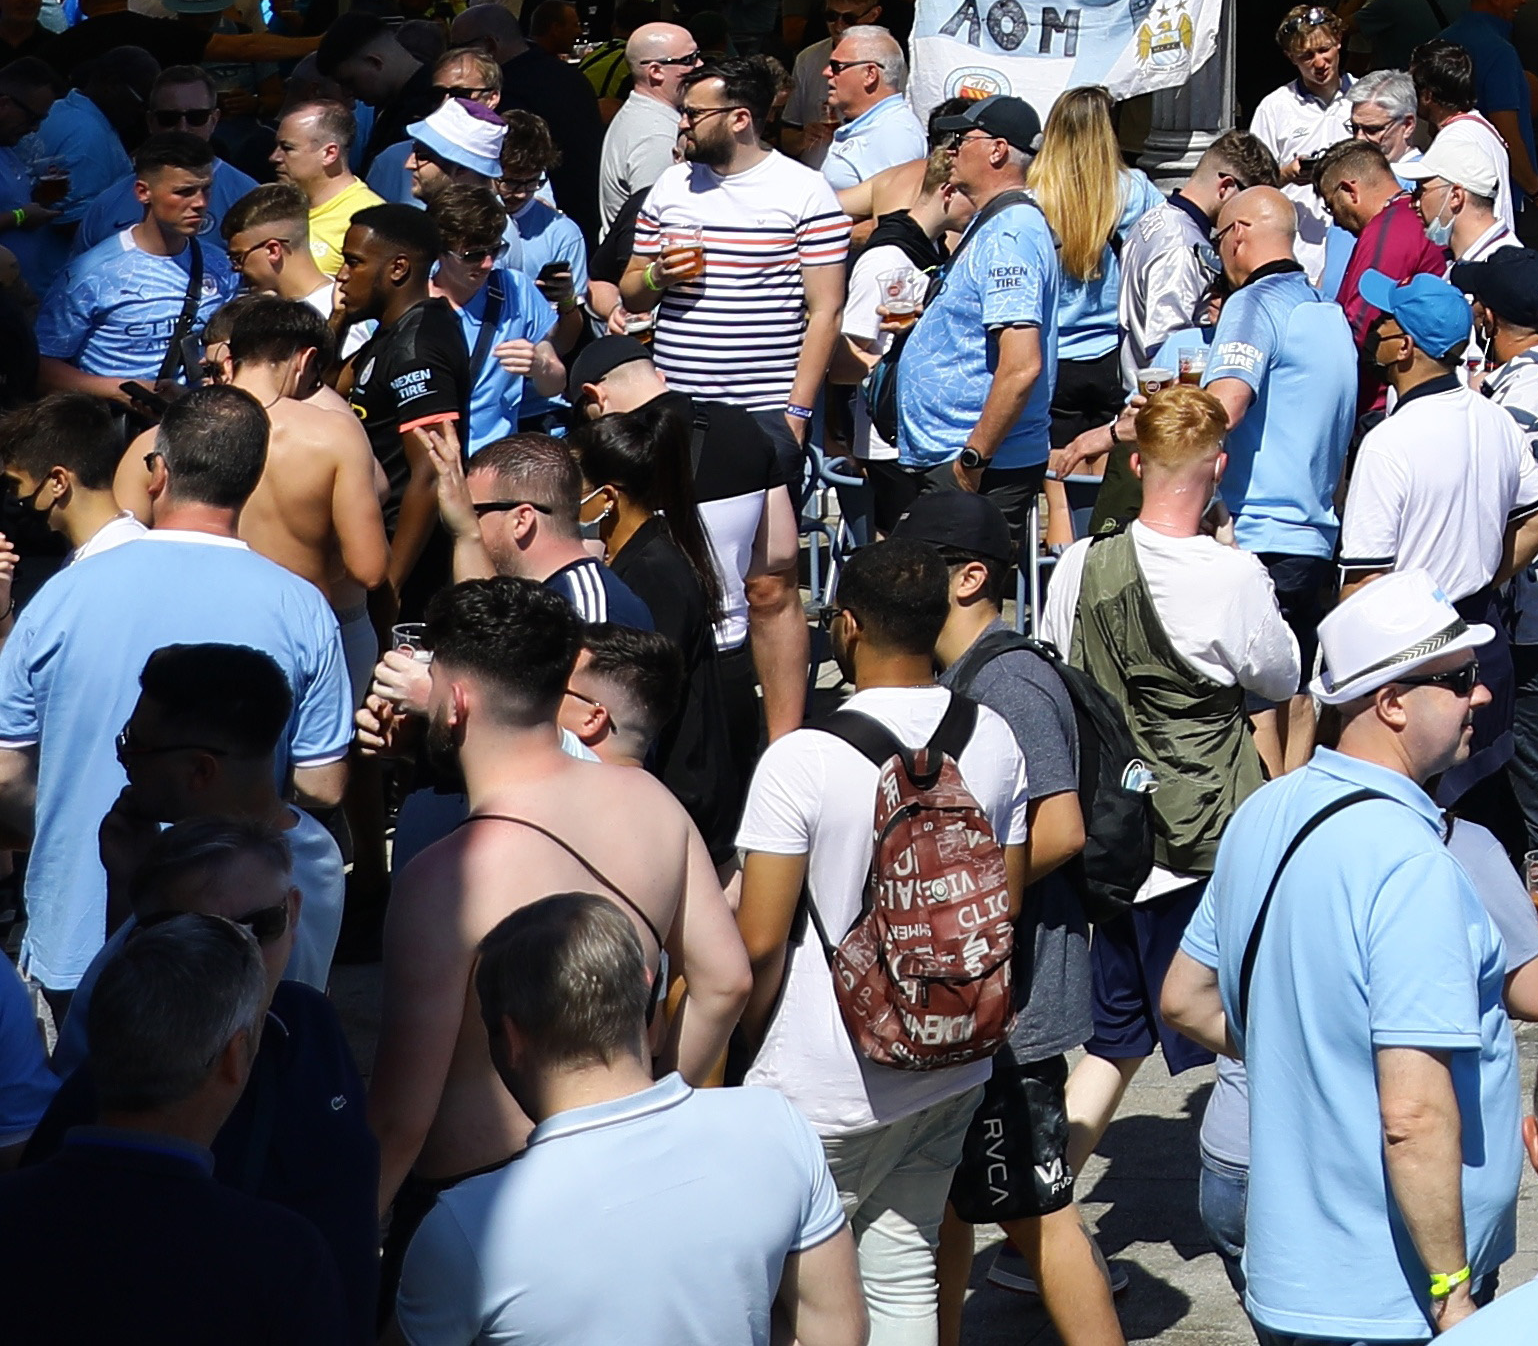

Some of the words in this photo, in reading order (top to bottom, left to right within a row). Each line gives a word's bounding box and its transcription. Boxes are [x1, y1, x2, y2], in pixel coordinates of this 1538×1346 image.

[988, 265, 1028, 279] NEXEN
[994, 277, 1021, 289] TIRE
[1218, 341, 1263, 363] NEXEN
[1223, 353, 1255, 370] TIRE
[390, 368, 431, 390] NEXEN
[398, 381, 428, 400] TIRE
[983, 1118, 1009, 1206] RVCA
